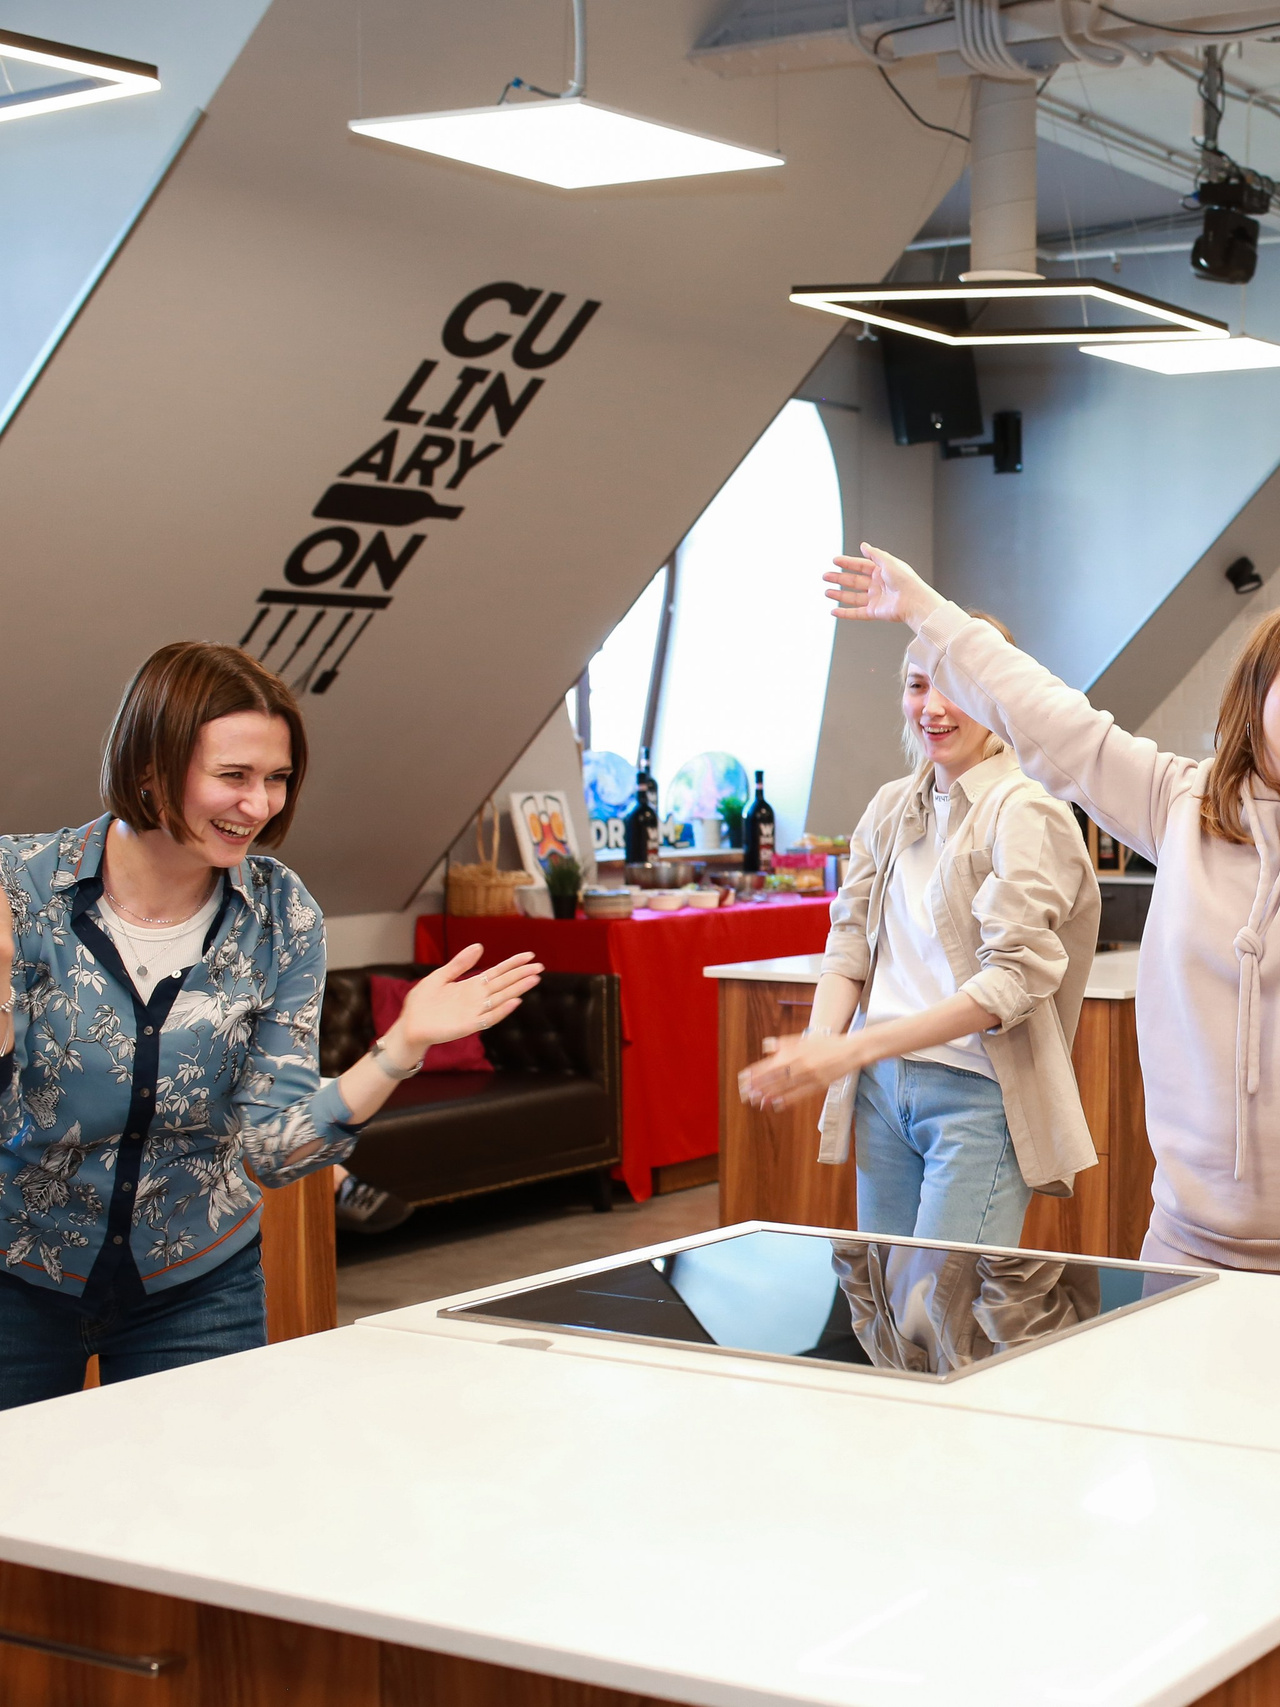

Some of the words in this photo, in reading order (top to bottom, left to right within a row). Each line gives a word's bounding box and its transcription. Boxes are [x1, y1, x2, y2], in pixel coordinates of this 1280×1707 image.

[441, 281, 602, 370] CU
[383, 359, 546, 438] LIN
[338, 428, 504, 490] ARY
[283, 525, 428, 592] ON
